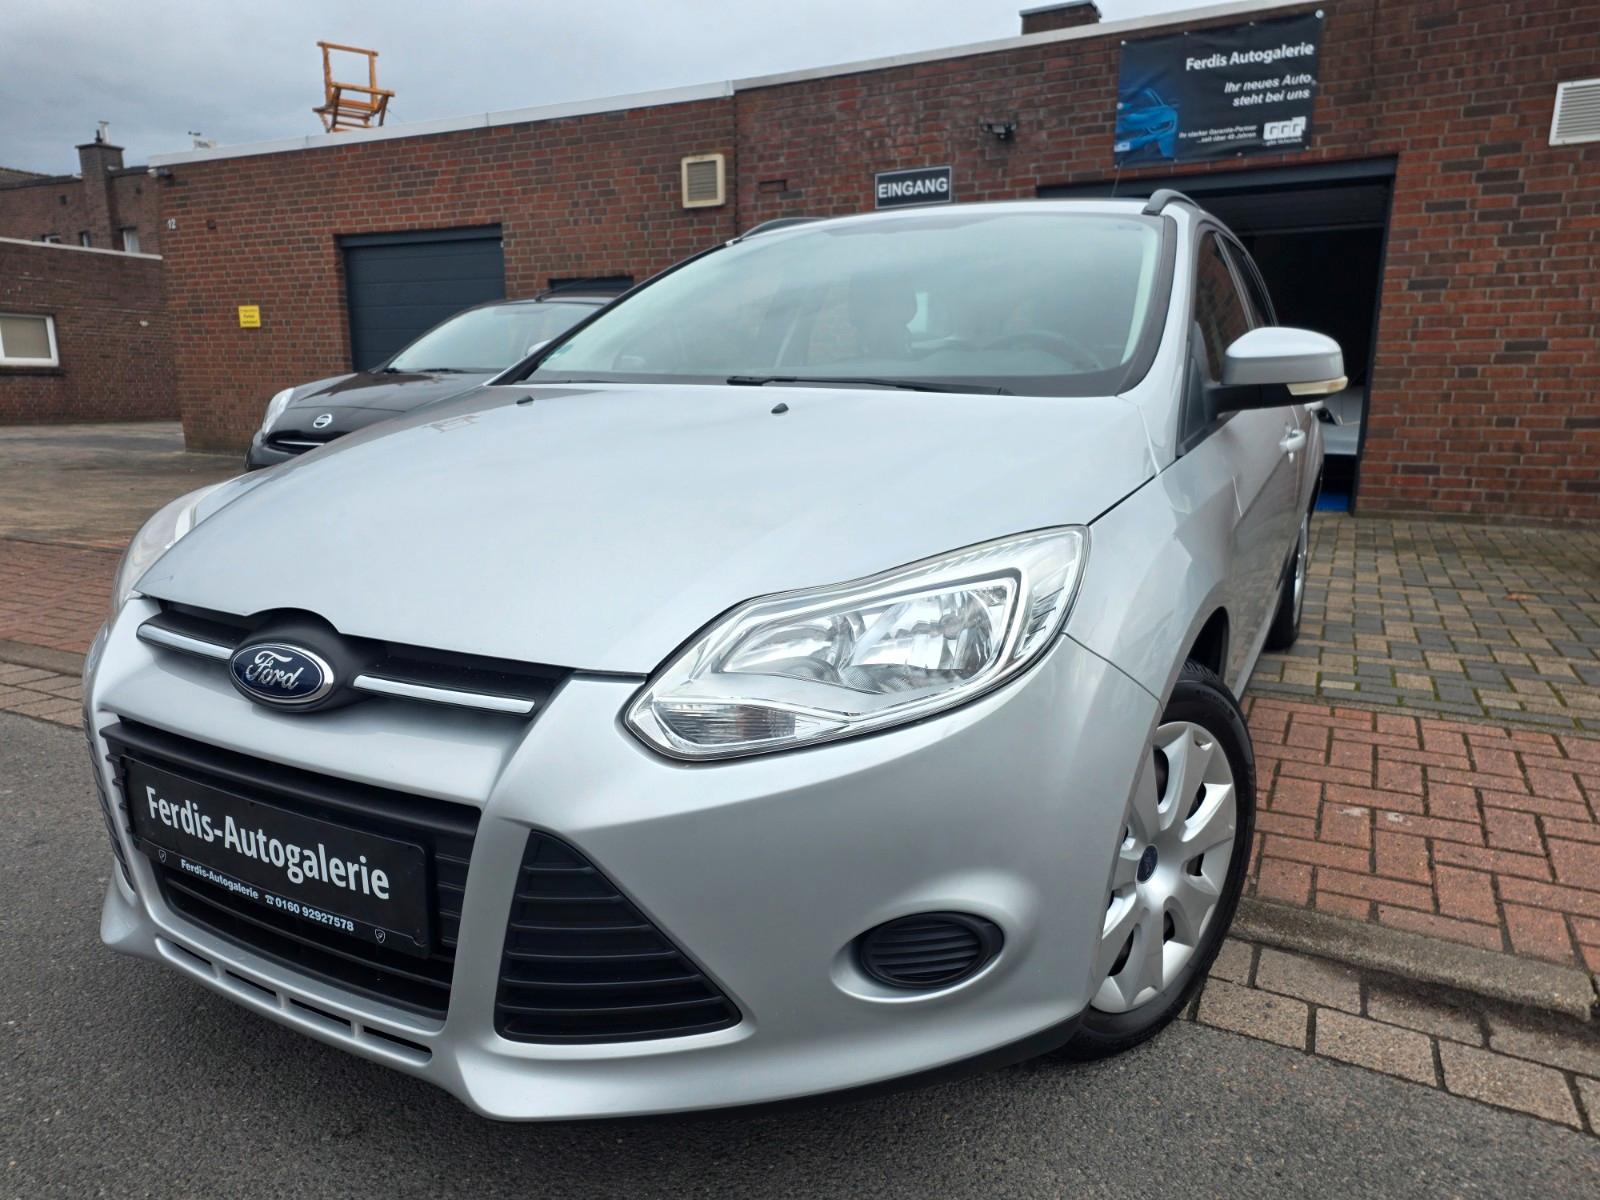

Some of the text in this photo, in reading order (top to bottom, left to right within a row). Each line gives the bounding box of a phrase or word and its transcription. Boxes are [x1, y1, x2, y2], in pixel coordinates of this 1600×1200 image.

[1186, 42, 1315, 71] Ferdis Autogalerie
[1224, 73, 1312, 94] Ihr neues Auto
[1232, 89, 1311, 107] steht bei uns
[878, 177, 948, 198] EINGANG
[246, 650, 304, 690] Ford
[146, 785, 390, 900] Ferdis-Autogalerie
[180, 858, 355, 932] Ferdis-Autogalerie 0160 92927578
